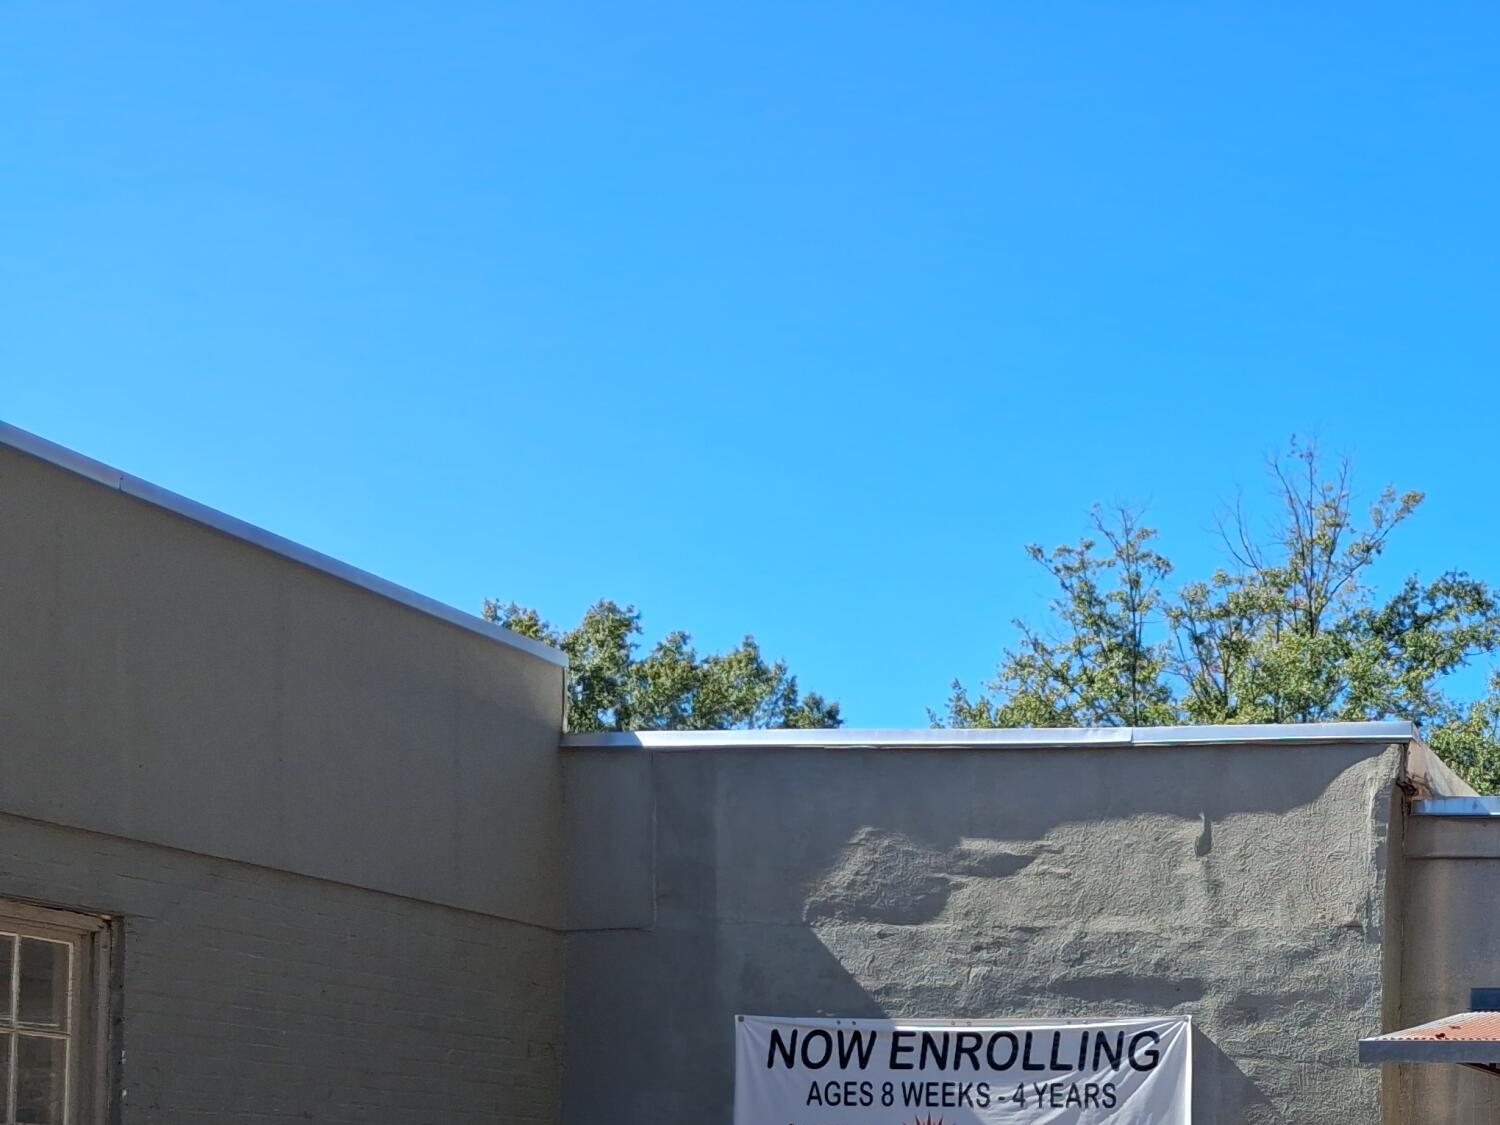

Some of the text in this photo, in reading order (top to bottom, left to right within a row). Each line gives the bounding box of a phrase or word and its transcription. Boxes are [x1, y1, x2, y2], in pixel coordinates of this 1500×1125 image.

[767, 1028, 1161, 1072] NOW ENROLLING
[806, 1080, 873, 1107] AGES
[881, 1081, 894, 1107] 8
[901, 1081, 991, 1109] WEEKS
[1012, 1082, 1026, 1109] 4
[1033, 1082, 1117, 1109] YEARS
